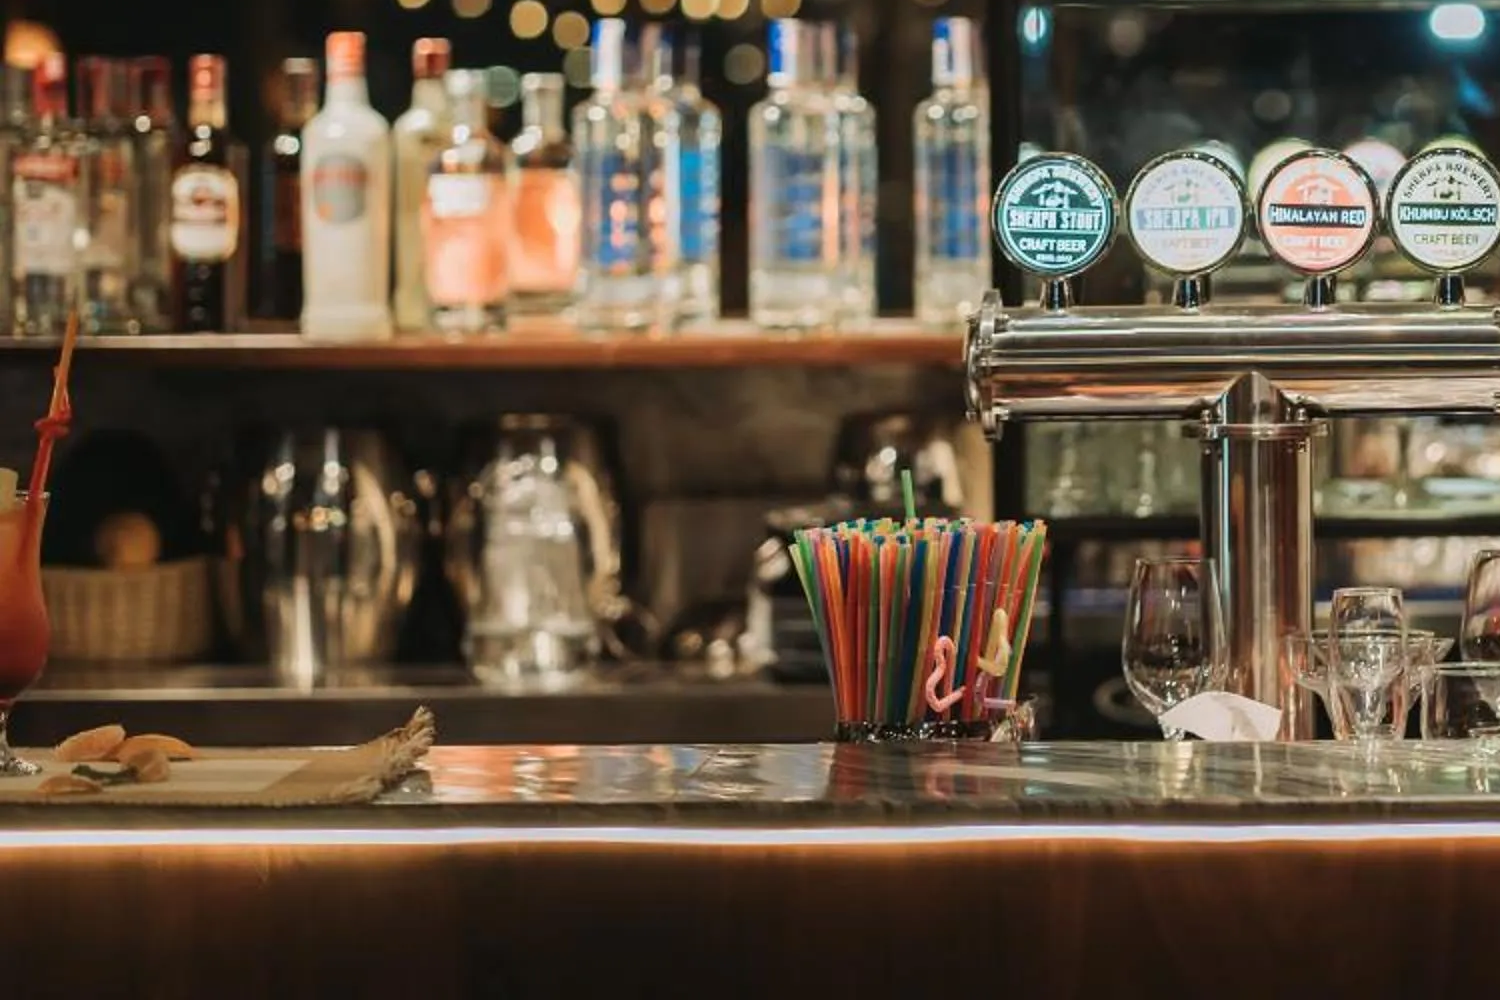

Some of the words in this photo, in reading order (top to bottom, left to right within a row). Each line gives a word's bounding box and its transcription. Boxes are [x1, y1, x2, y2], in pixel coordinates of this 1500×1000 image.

[1270, 206, 1338, 223] HIMALAYAN
[1340, 210, 1365, 225] RED
[1019, 237, 1056, 251] CRAFT
[1057, 239, 1087, 252] BEER
[1413, 233, 1448, 245] CRAFT
[1450, 233, 1479, 245] BEER
